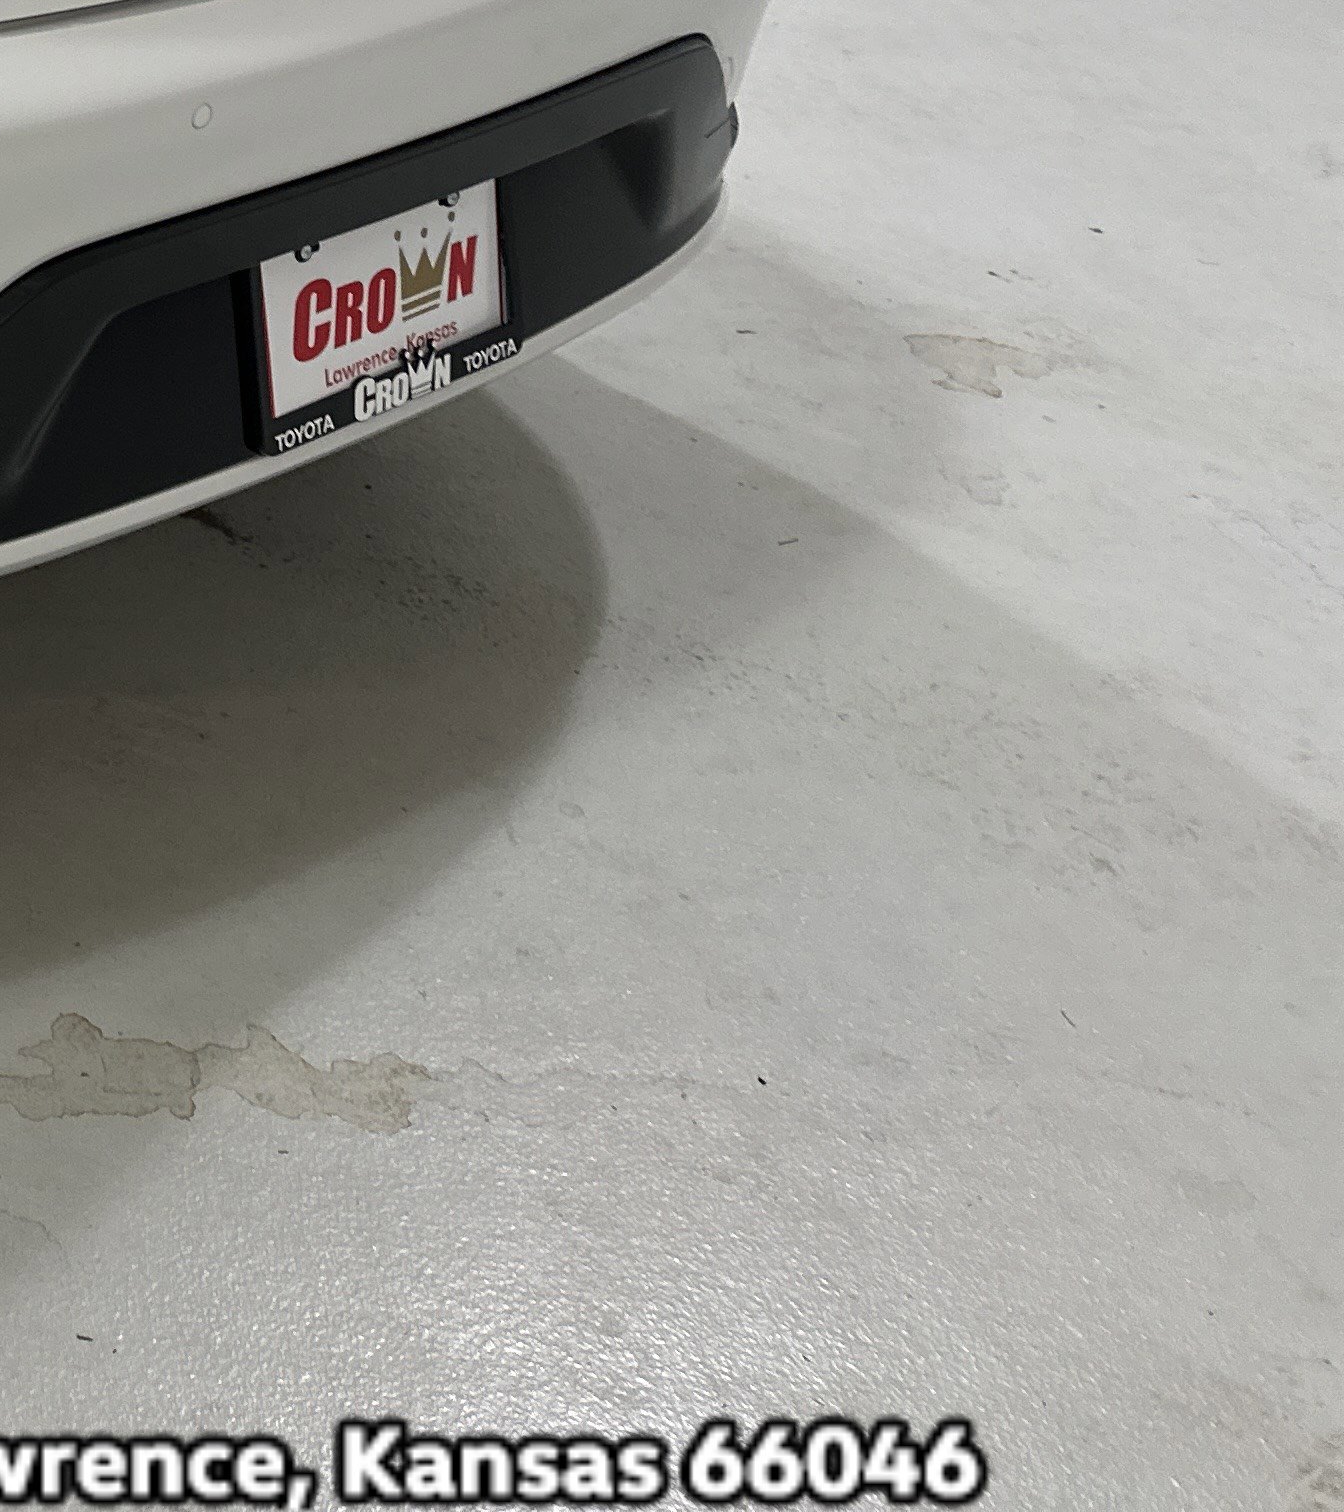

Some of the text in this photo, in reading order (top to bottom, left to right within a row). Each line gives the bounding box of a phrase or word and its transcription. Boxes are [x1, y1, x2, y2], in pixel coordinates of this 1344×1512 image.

[292, 229, 479, 363] CROWN
[274, 338, 518, 452] TOYOTA CROWN TOYOTA
